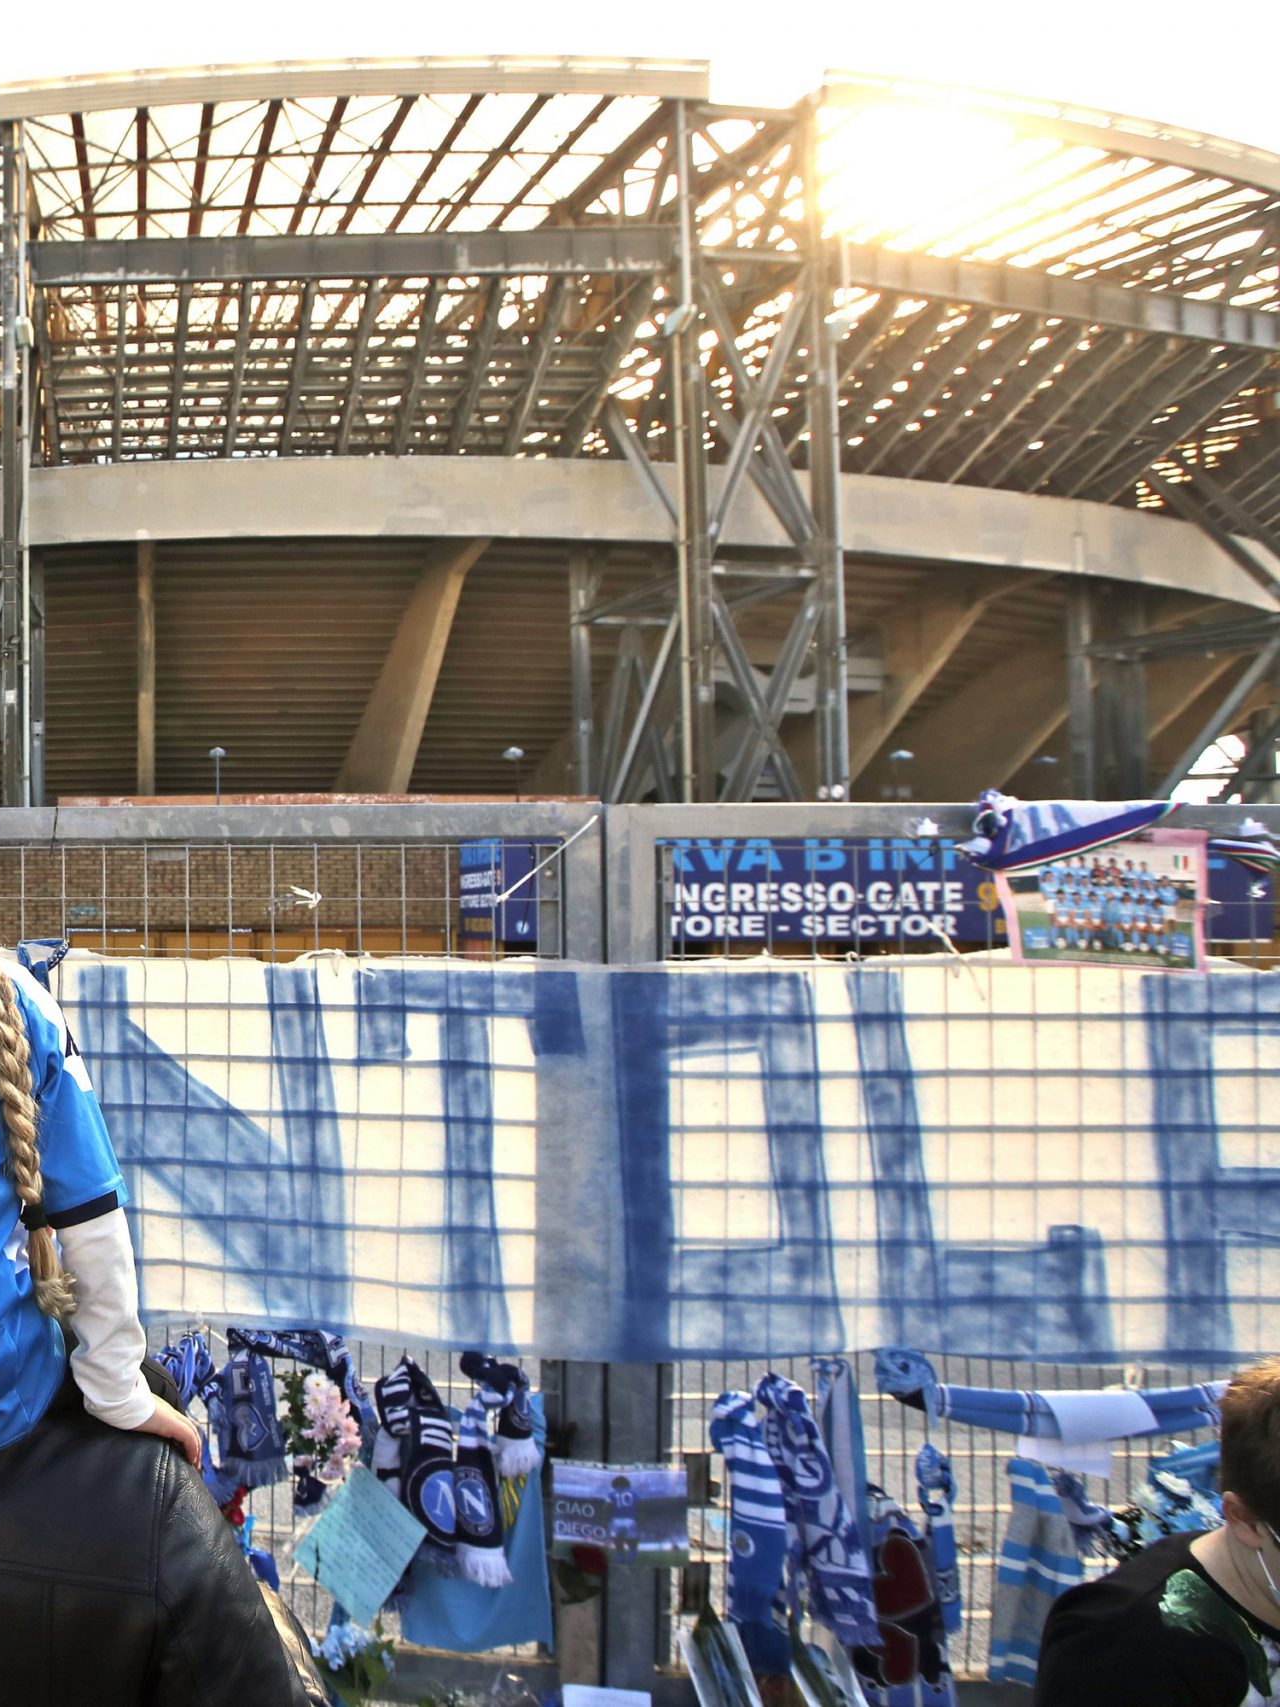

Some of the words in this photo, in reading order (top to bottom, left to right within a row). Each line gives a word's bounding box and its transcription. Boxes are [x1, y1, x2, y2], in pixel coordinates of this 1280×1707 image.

[801, 915, 958, 937] SECTOR
[554, 1501, 596, 1518] CIAO
[555, 1520, 607, 1539] DIEGO
